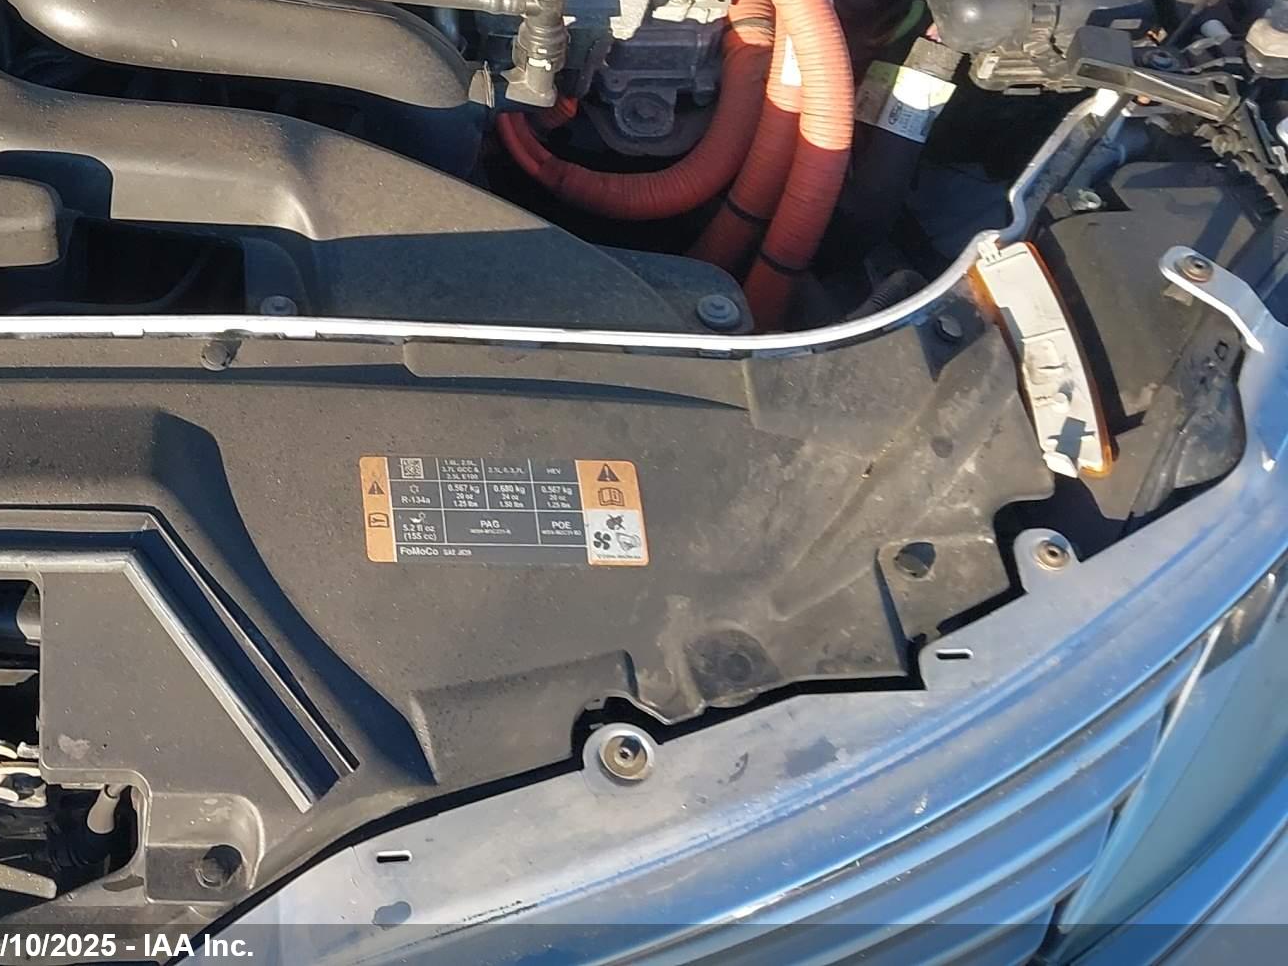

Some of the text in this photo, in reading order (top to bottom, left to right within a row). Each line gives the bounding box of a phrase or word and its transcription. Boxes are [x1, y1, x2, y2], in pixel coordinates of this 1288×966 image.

[401, 495, 431, 504] R-134a
[402, 524, 415, 532] 5.2
[480, 520, 500, 528] PAG
[552, 521, 572, 529] POE
[403, 532, 437, 541] (155 cc)
[400, 546, 439, 555] FoMoCo
